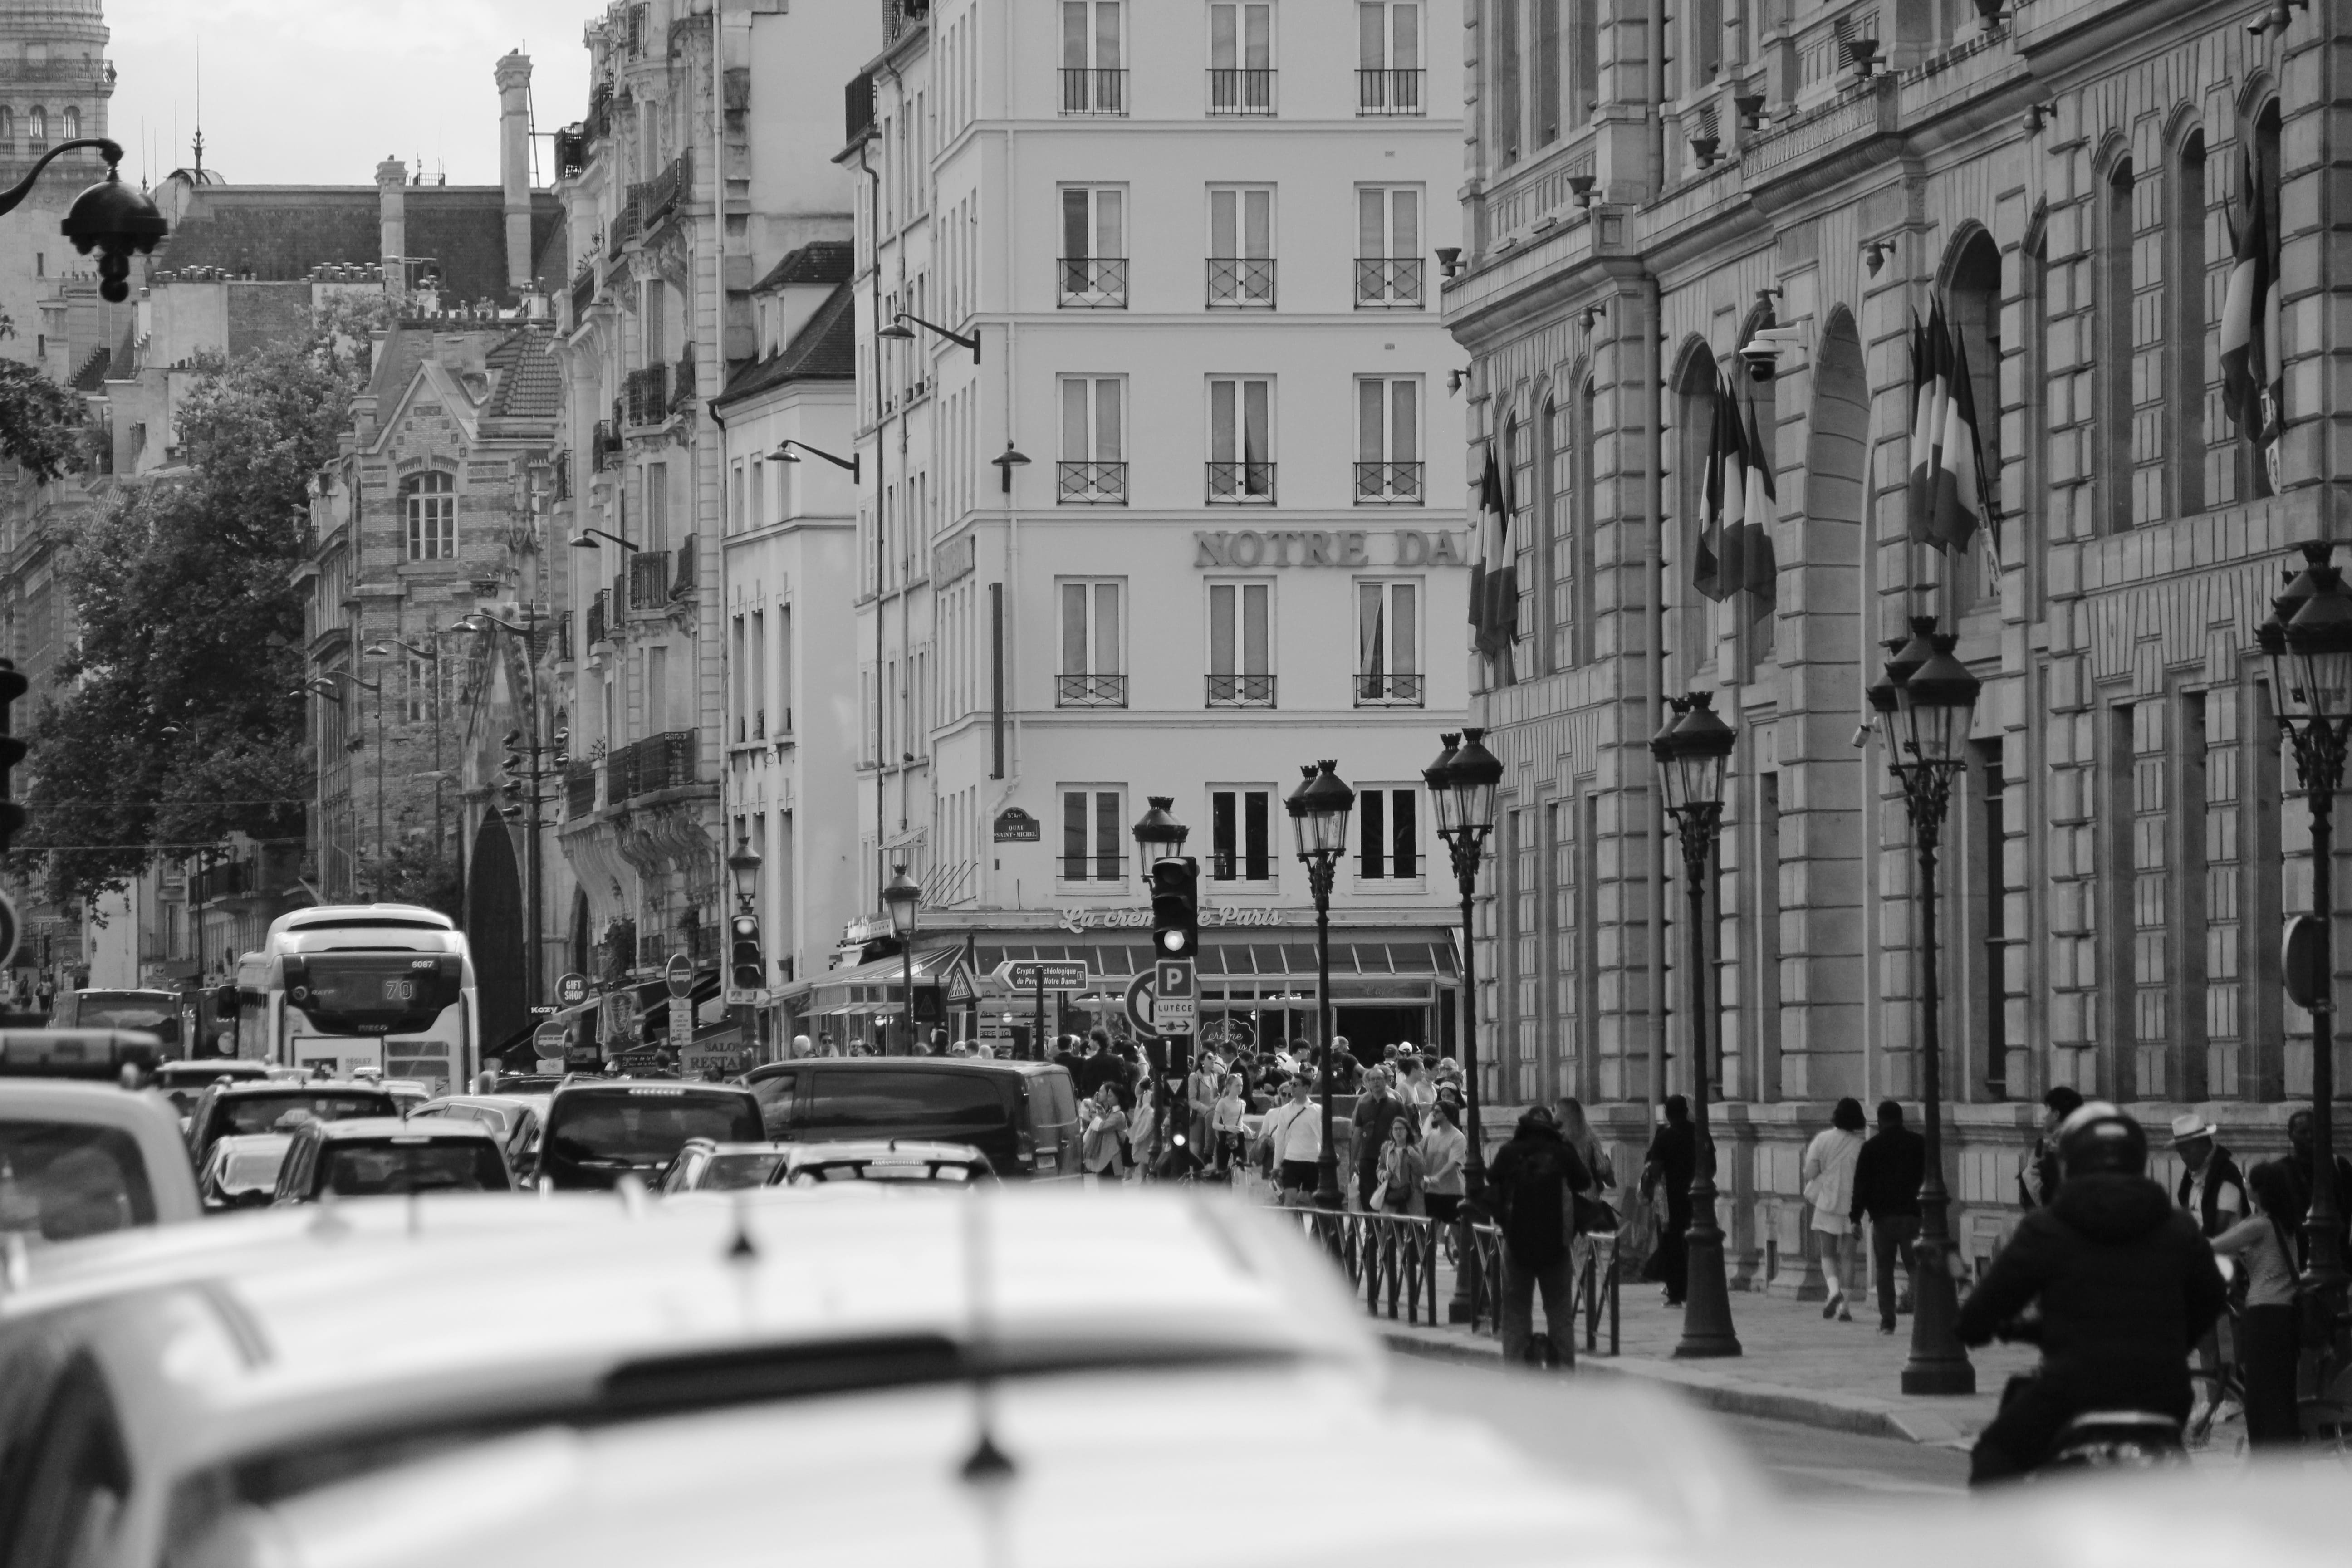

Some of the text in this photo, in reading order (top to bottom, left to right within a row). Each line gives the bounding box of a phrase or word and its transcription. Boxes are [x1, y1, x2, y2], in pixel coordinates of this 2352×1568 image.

[1193, 529, 1467, 568] NOTRE DA
[1058, 906, 1283, 934] La crèm e Paris
[1016, 967, 1035, 976] Crypte
[566, 980, 581, 990] GIFT
[1166, 968, 1183, 991] P
[386, 981, 412, 999] 70
[564, 990, 583, 1000] SHOP
[705, 1043, 737, 1052] SALO
[690, 1057, 737, 1068] RESTA
